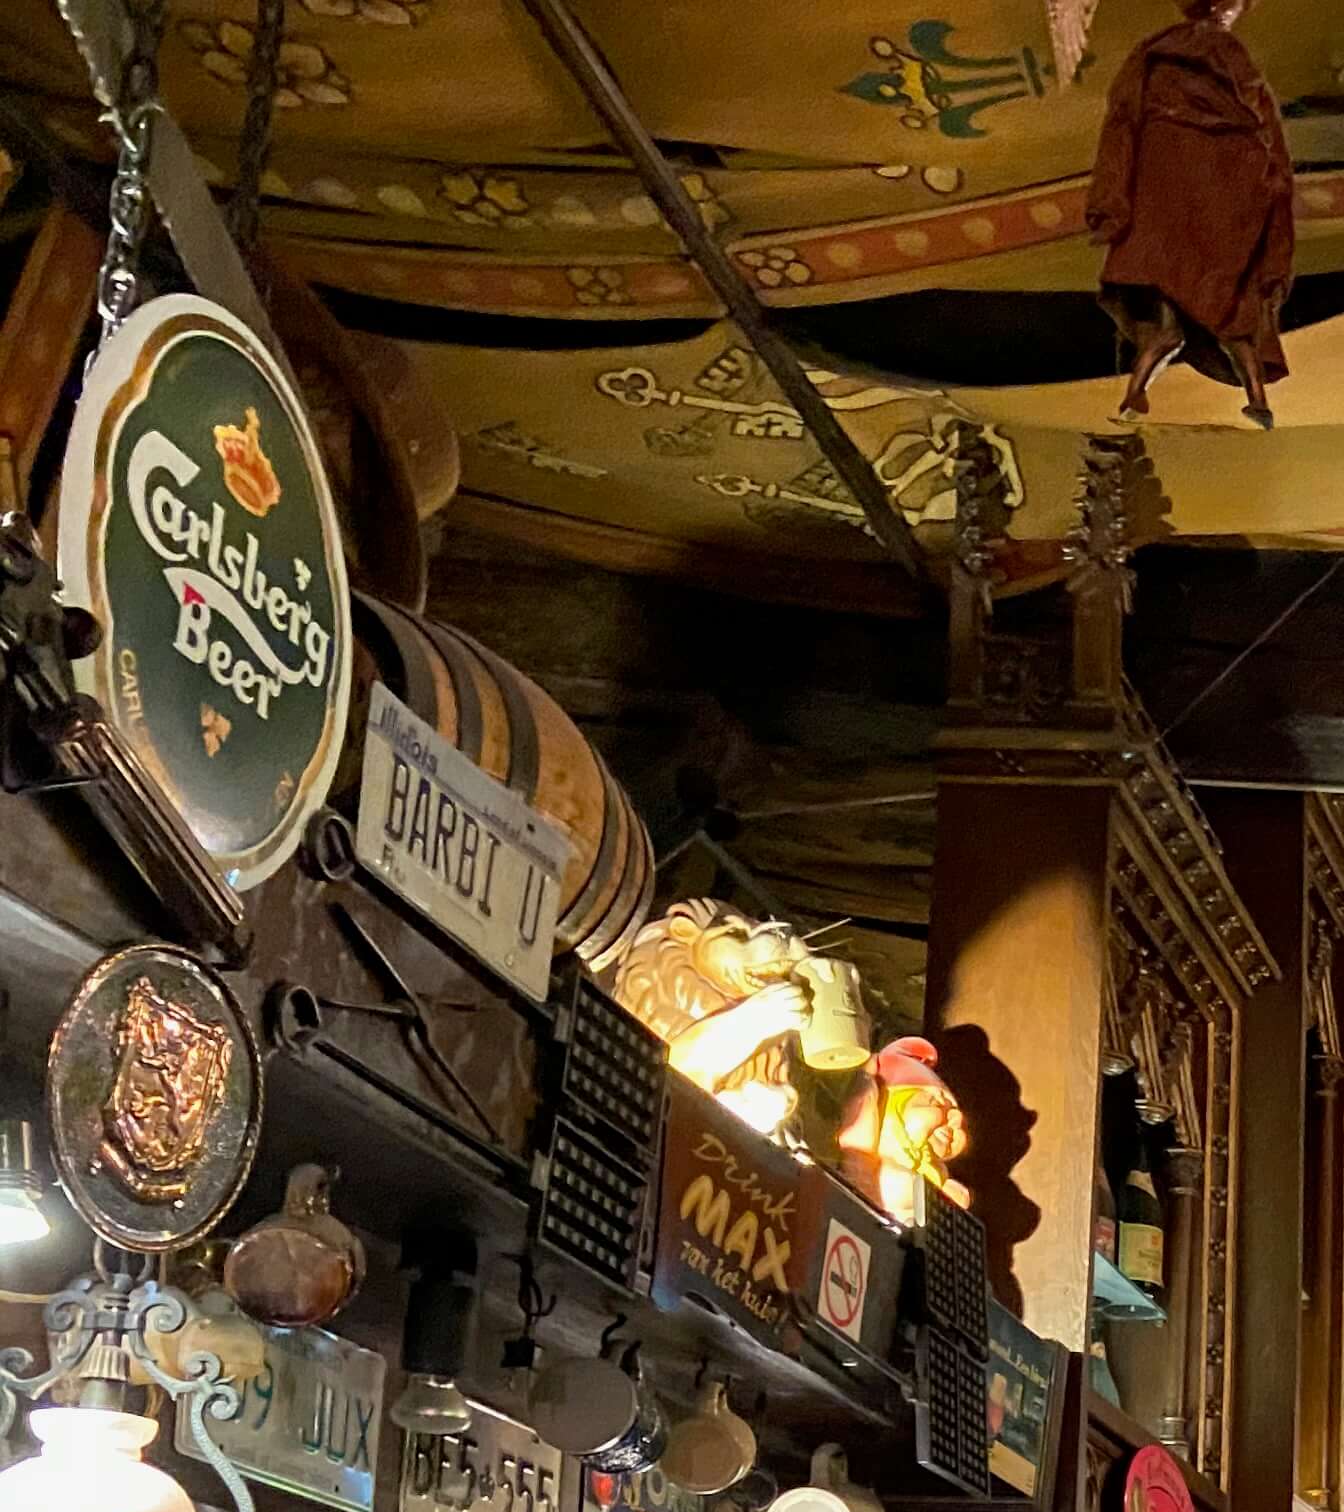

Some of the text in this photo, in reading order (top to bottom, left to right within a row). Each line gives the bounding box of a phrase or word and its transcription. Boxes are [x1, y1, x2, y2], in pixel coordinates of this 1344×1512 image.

[128, 430, 330, 688] Carlsberg
[172, 583, 283, 720] Beer
[384, 754, 501, 918] BARBI
[518, 864, 546, 948] U
[680, 1174, 791, 1294] MAX
[692, 1131, 797, 1232] Drink
